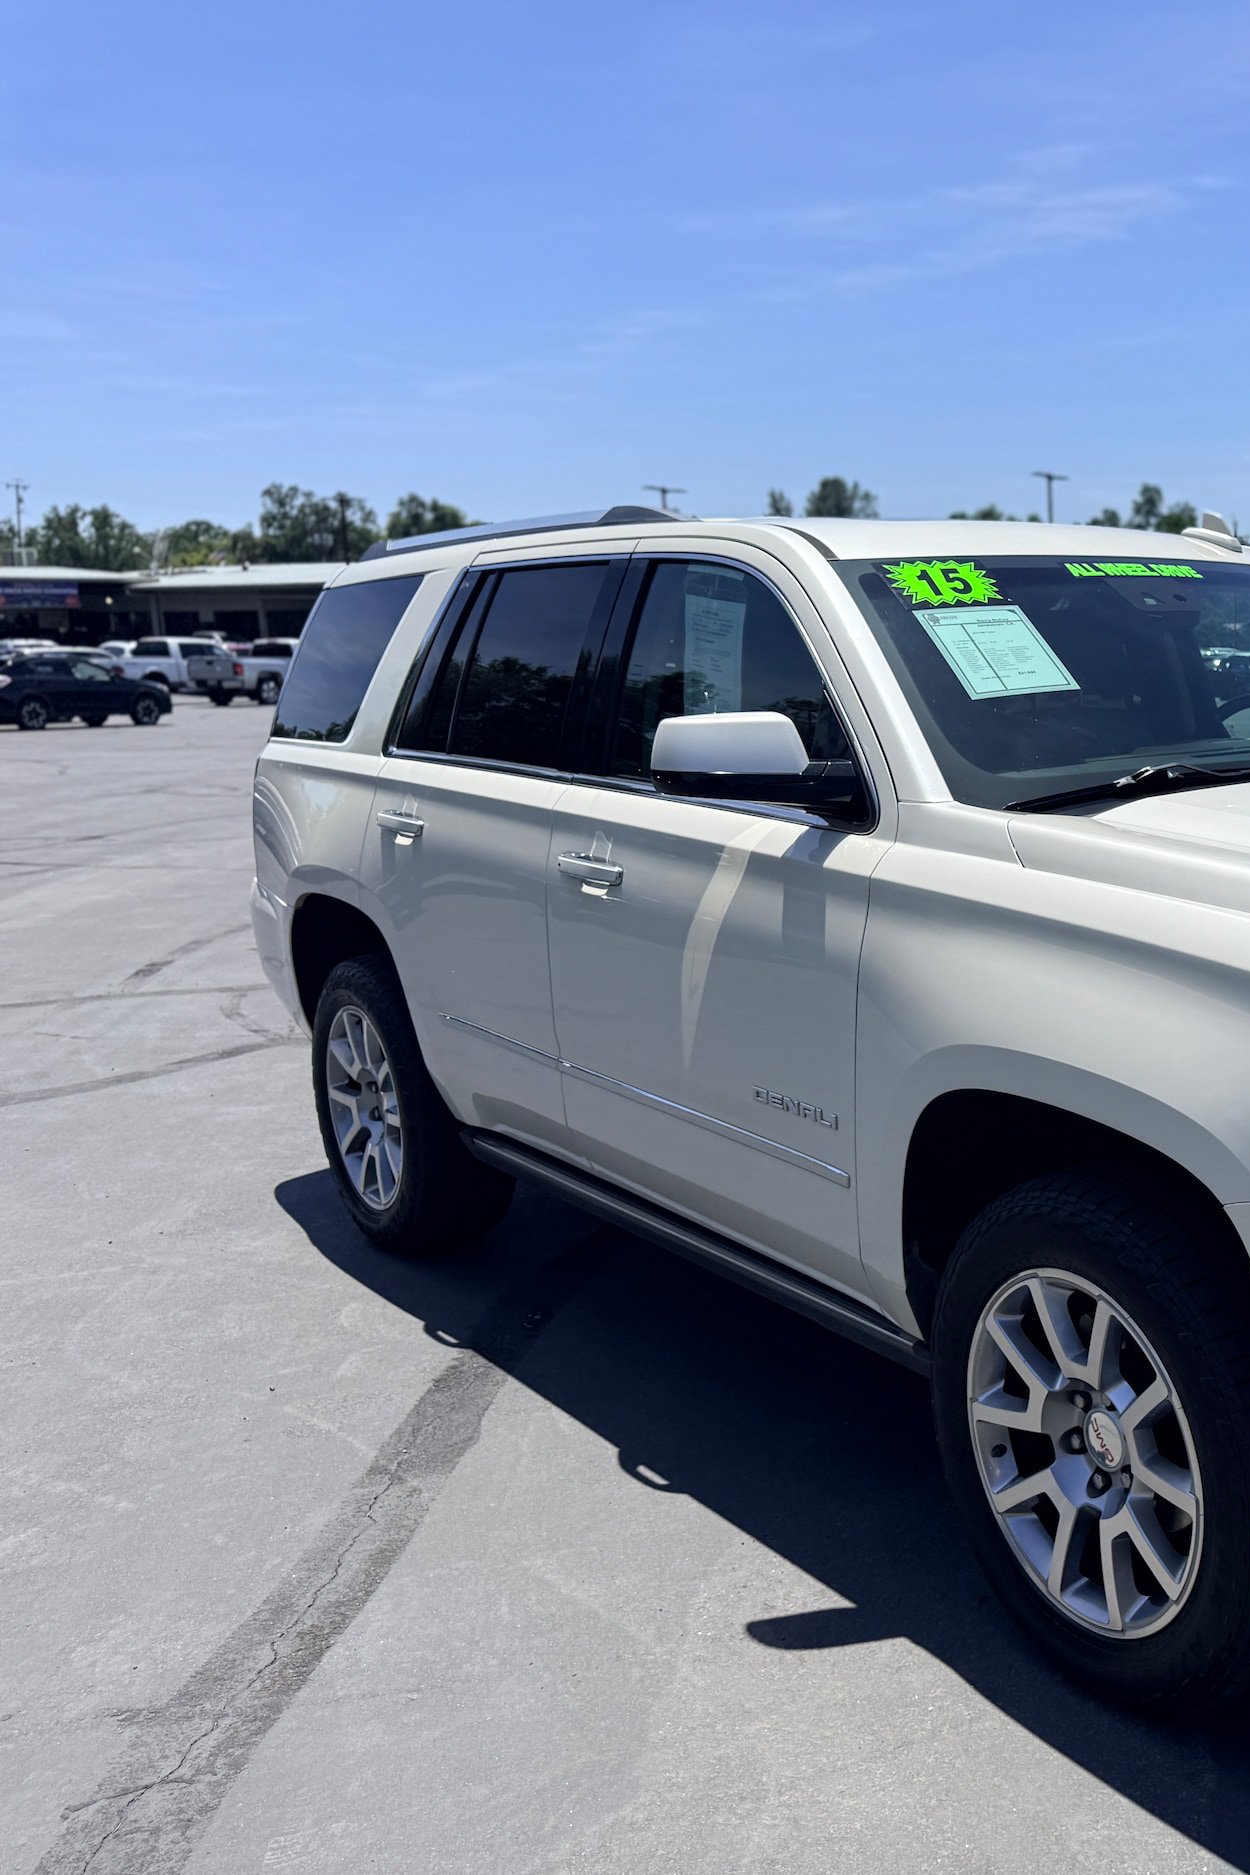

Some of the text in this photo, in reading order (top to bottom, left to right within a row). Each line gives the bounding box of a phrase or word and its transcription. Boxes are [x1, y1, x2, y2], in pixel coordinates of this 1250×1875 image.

[916, 568, 973, 596] 15
[1064, 563, 1204, 579] ALL WHEEL DRIVE
[752, 1084, 838, 1130] DENALI
[1090, 1417, 1114, 1463] GMC
